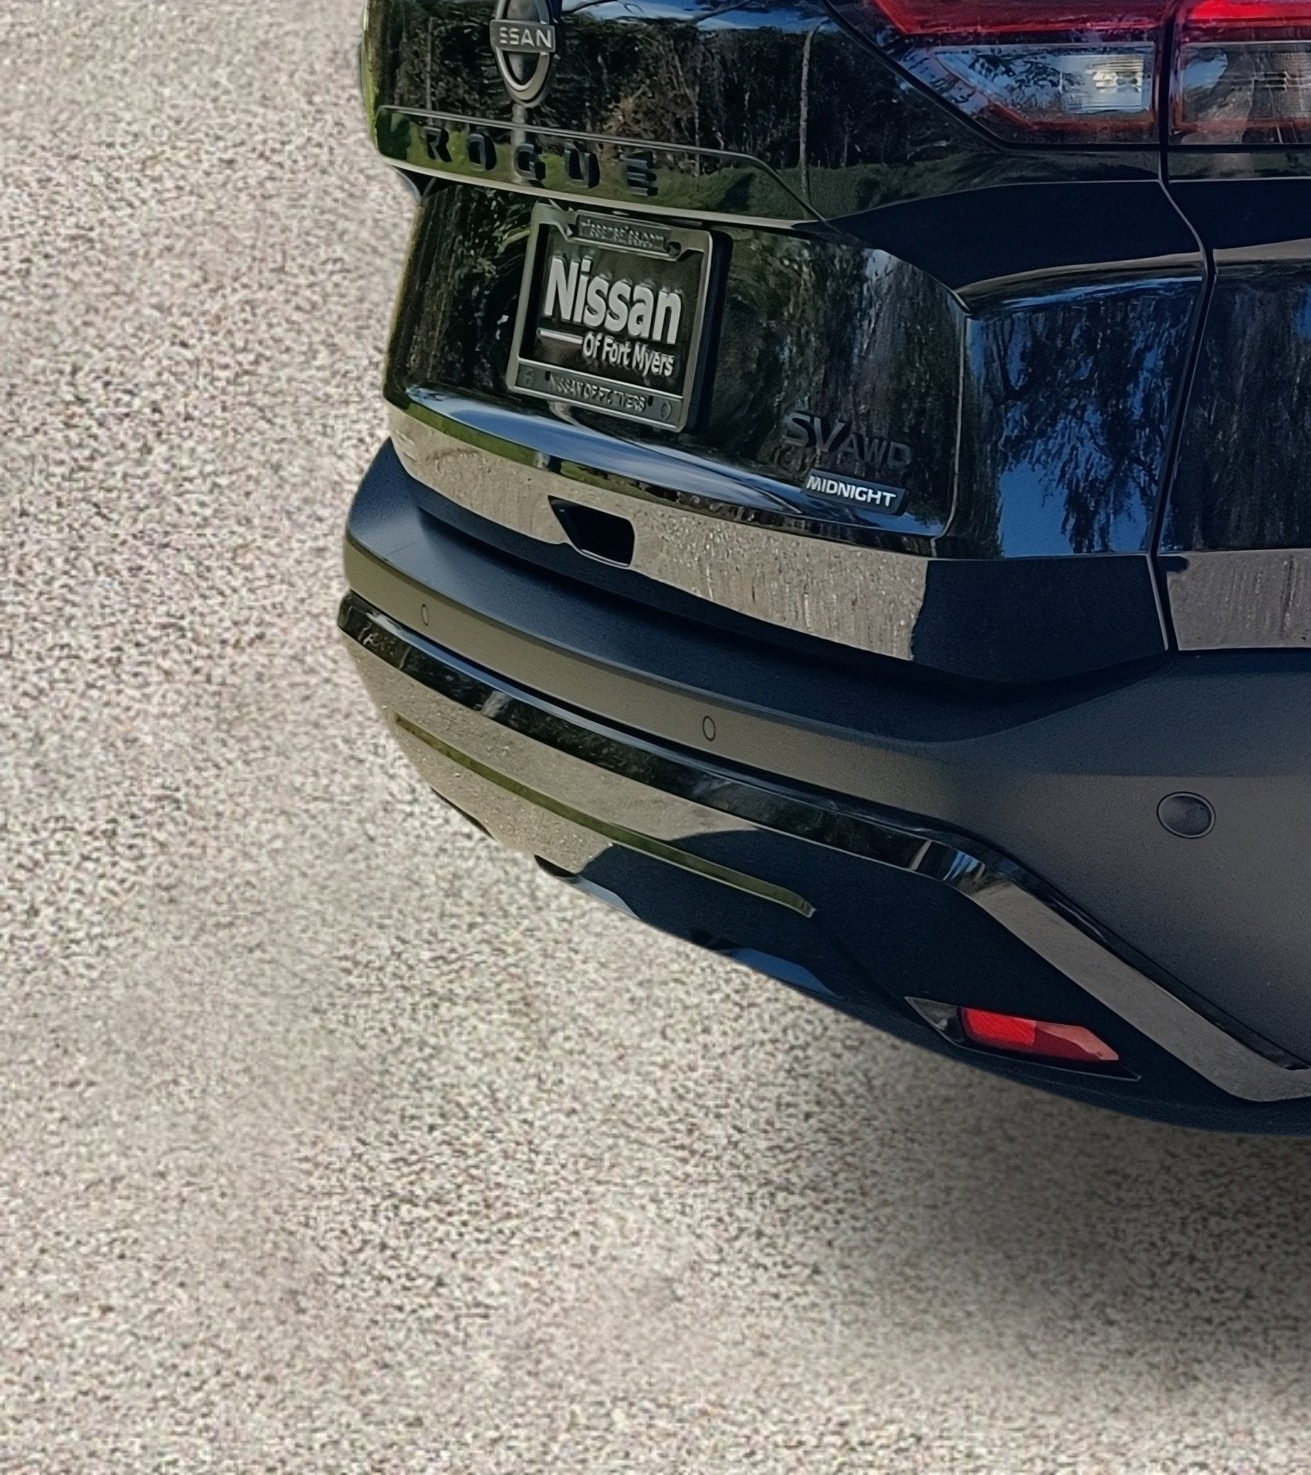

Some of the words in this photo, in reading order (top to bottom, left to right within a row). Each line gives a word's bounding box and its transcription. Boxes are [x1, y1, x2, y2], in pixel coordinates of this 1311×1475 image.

[423, 125, 659, 197] ROGUE
[544, 254, 682, 345] Nissan
[583, 331, 602, 357] Of
[602, 335, 631, 367] Fort
[632, 341, 675, 377] Myers
[781, 411, 846, 454] SV
[838, 432, 912, 470] AWD
[806, 475, 897, 508] MIDNIGHT
